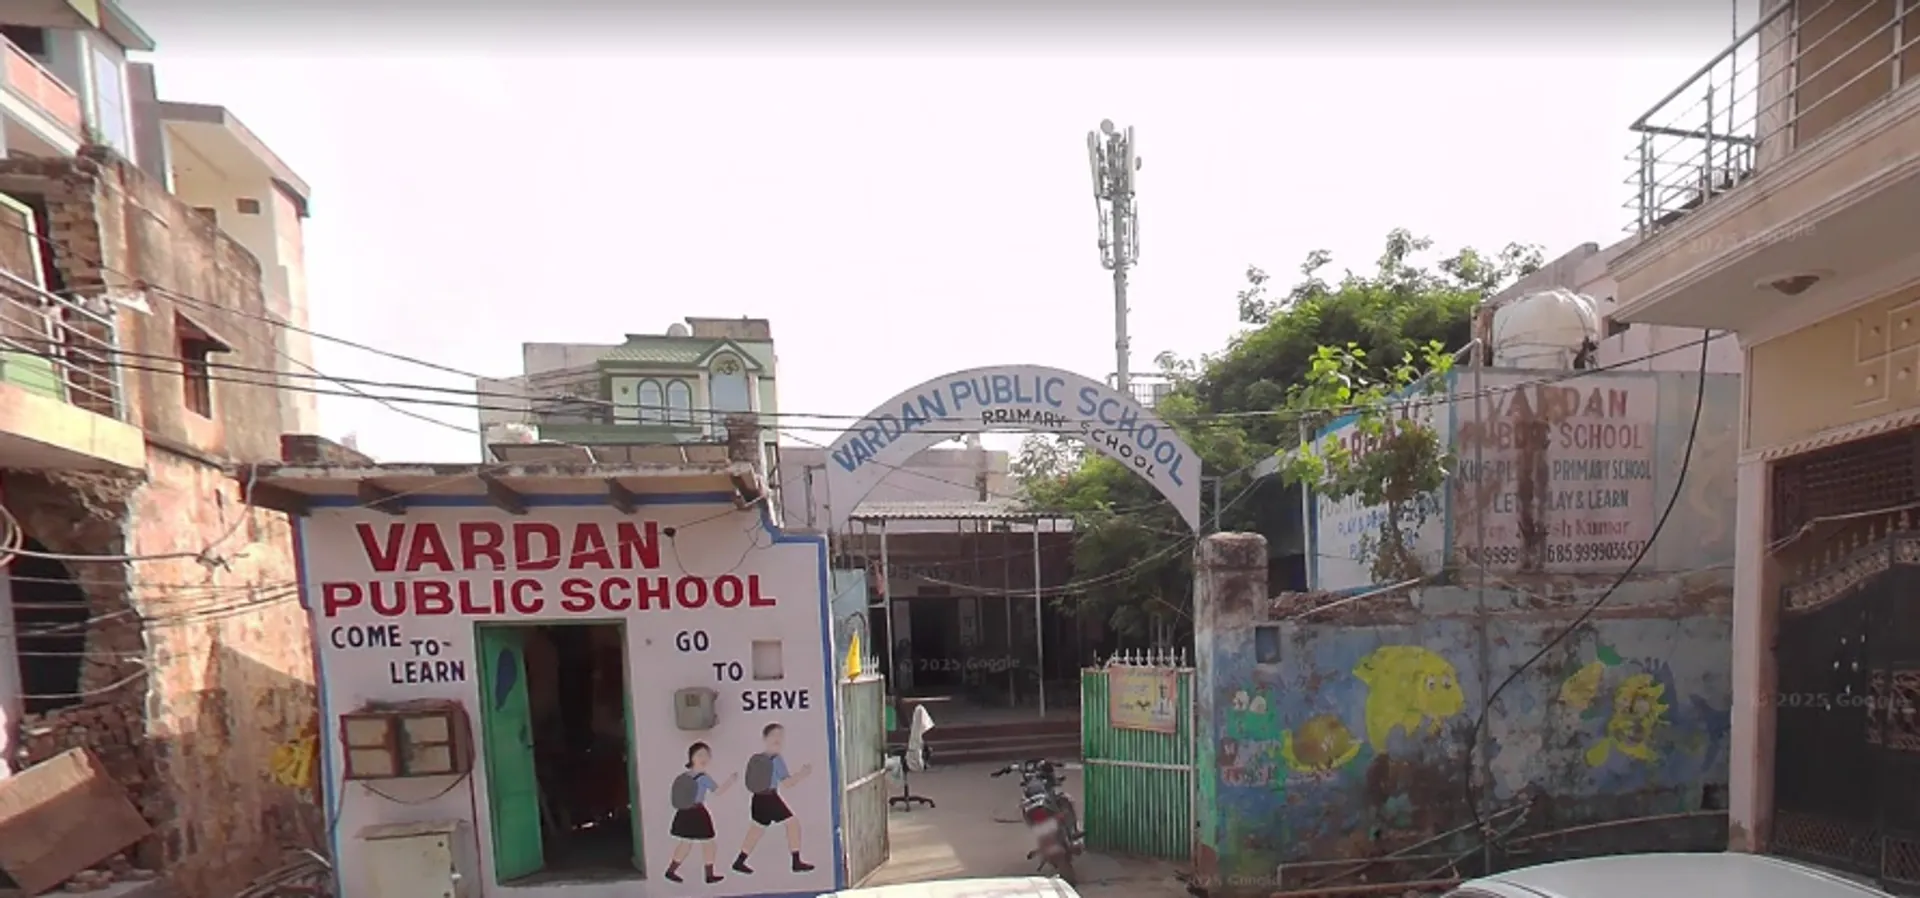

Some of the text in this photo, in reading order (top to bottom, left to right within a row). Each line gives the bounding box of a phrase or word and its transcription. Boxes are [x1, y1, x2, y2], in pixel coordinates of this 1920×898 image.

[832, 375, 1184, 487] VARDAN PUBLIC SCHOOL
[1559, 421, 1644, 450] SCHOOL
[1080, 420, 1155, 479] SCHOOL
[1552, 458, 1609, 481] PRIMARY
[1612, 459, 1652, 480] SCHOOL
[1588, 488, 1630, 509] LEARN
[358, 520, 661, 573] VARDAN
[322, 574, 777, 618] PUBLIC SCHOOL
[331, 624, 402, 650] COME
[675, 630, 710, 653] GO
[390, 660, 467, 685] LEARN
[712, 661, 744, 683] TO
[741, 689, 810, 713] SERVE
